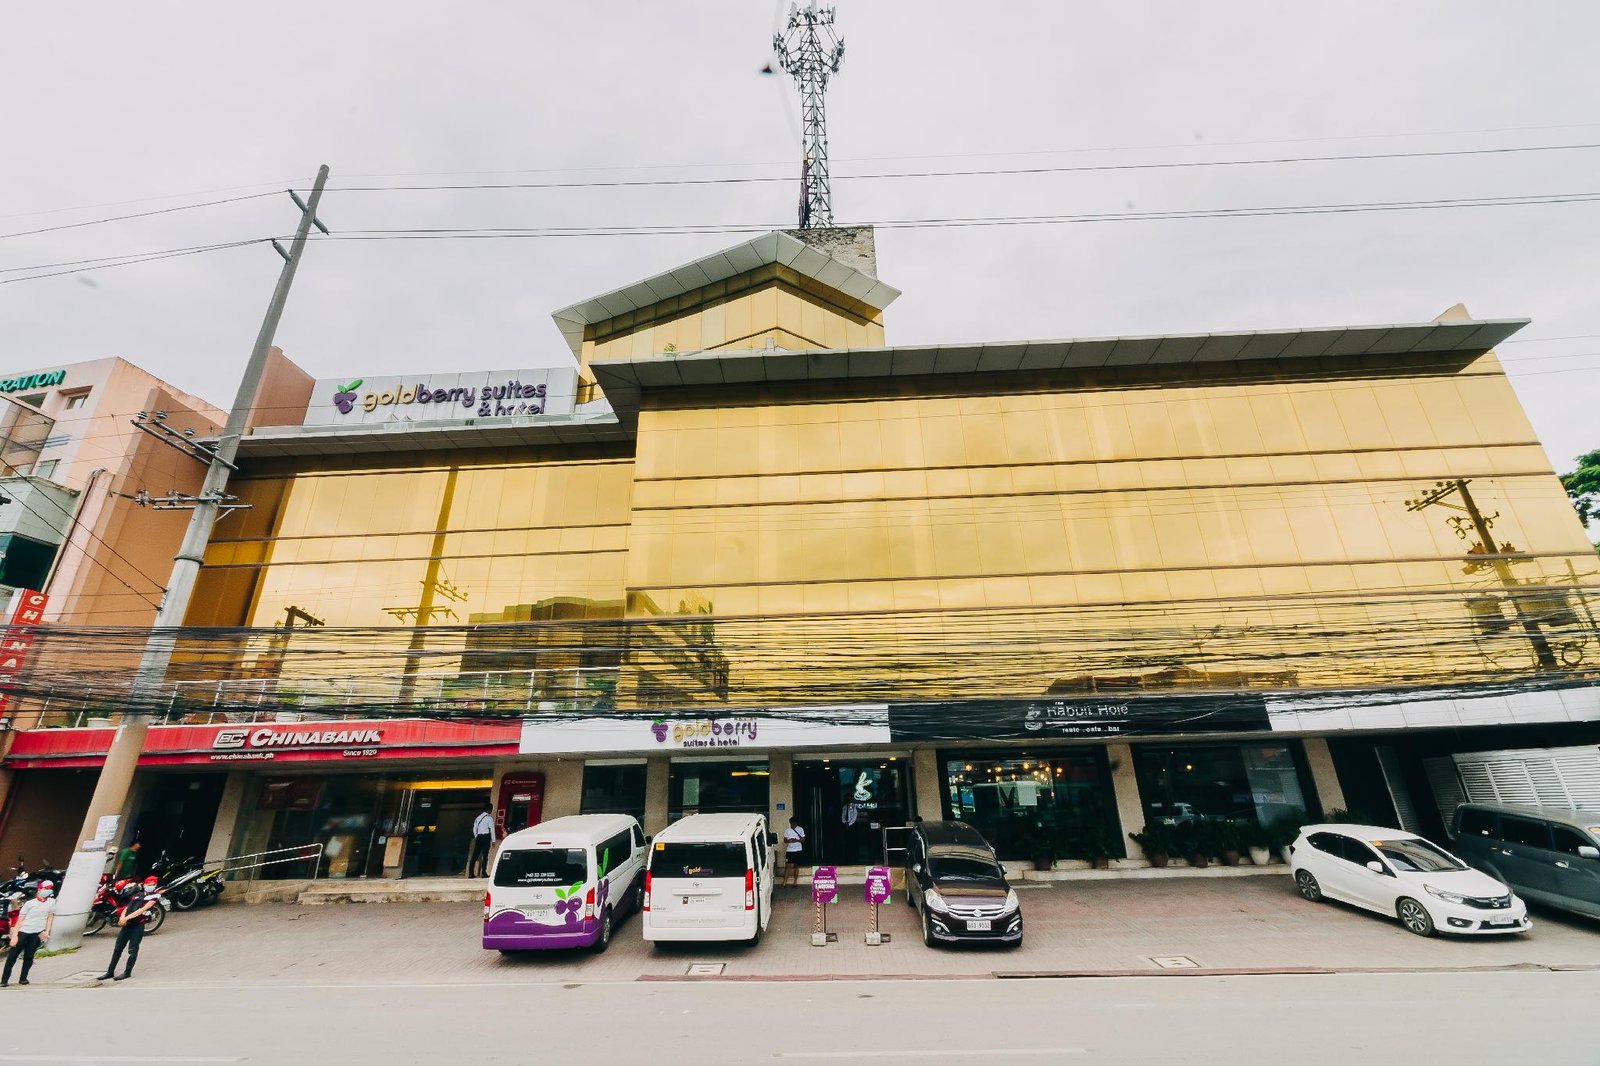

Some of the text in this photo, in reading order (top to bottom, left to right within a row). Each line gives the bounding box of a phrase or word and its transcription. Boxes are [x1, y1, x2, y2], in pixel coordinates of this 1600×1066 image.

[363, 380, 547, 412] goldberry suites
[477, 400, 491, 417] &
[250, 728, 382, 747] CHINABANK
[683, 736, 740, 747] suites & hotel
